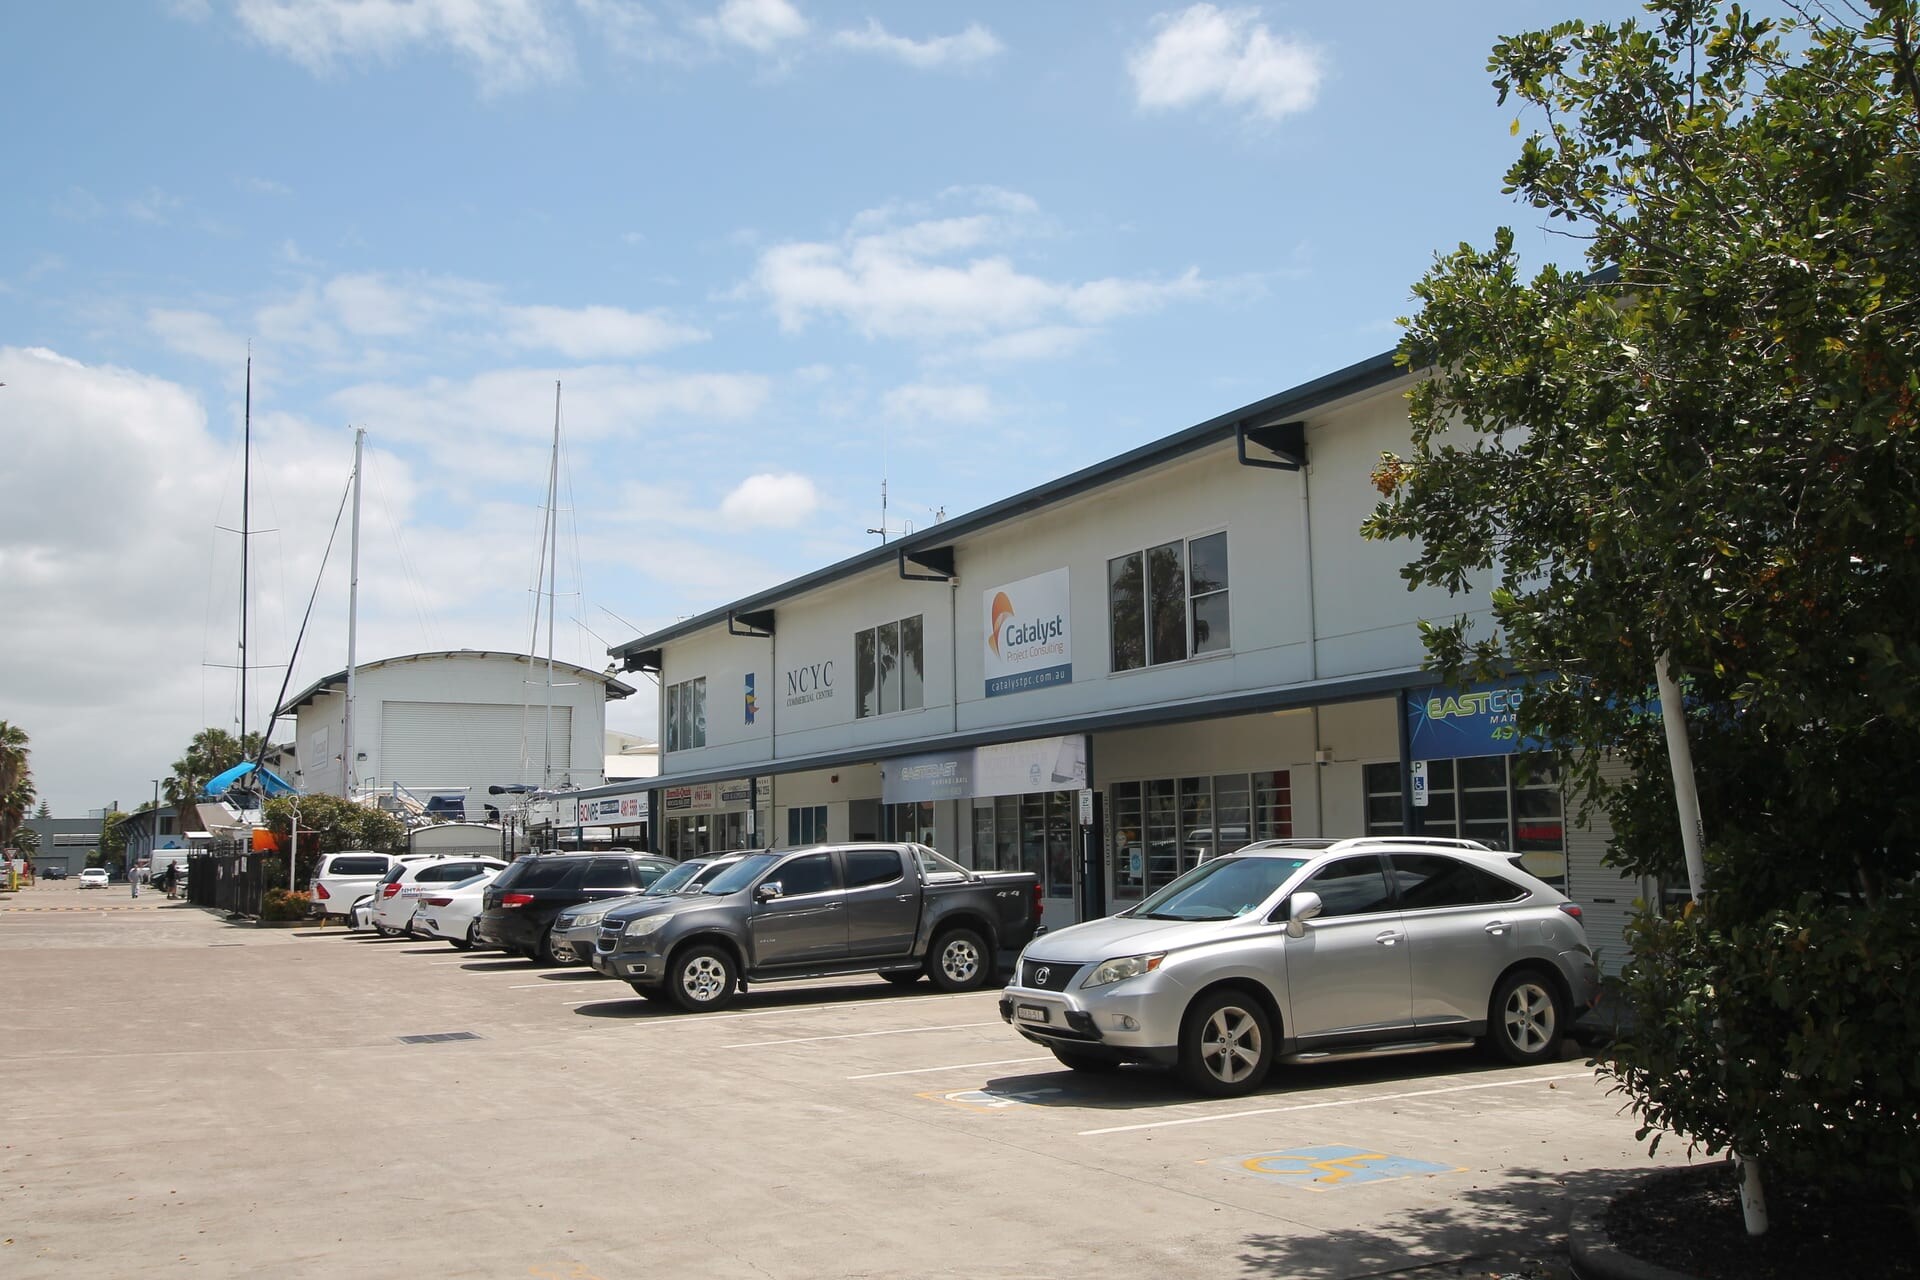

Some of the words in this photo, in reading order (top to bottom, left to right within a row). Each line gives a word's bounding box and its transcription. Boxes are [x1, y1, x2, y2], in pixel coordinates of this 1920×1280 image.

[1006, 615, 1063, 647] Catalyst
[1007, 649, 1028, 663] Project
[1029, 642, 1064, 656] Consulting
[787, 661, 833, 696] NCYC
[991, 670, 1065, 692] catalystpc.com.au
[1428, 689, 1524, 720] EASTCO
